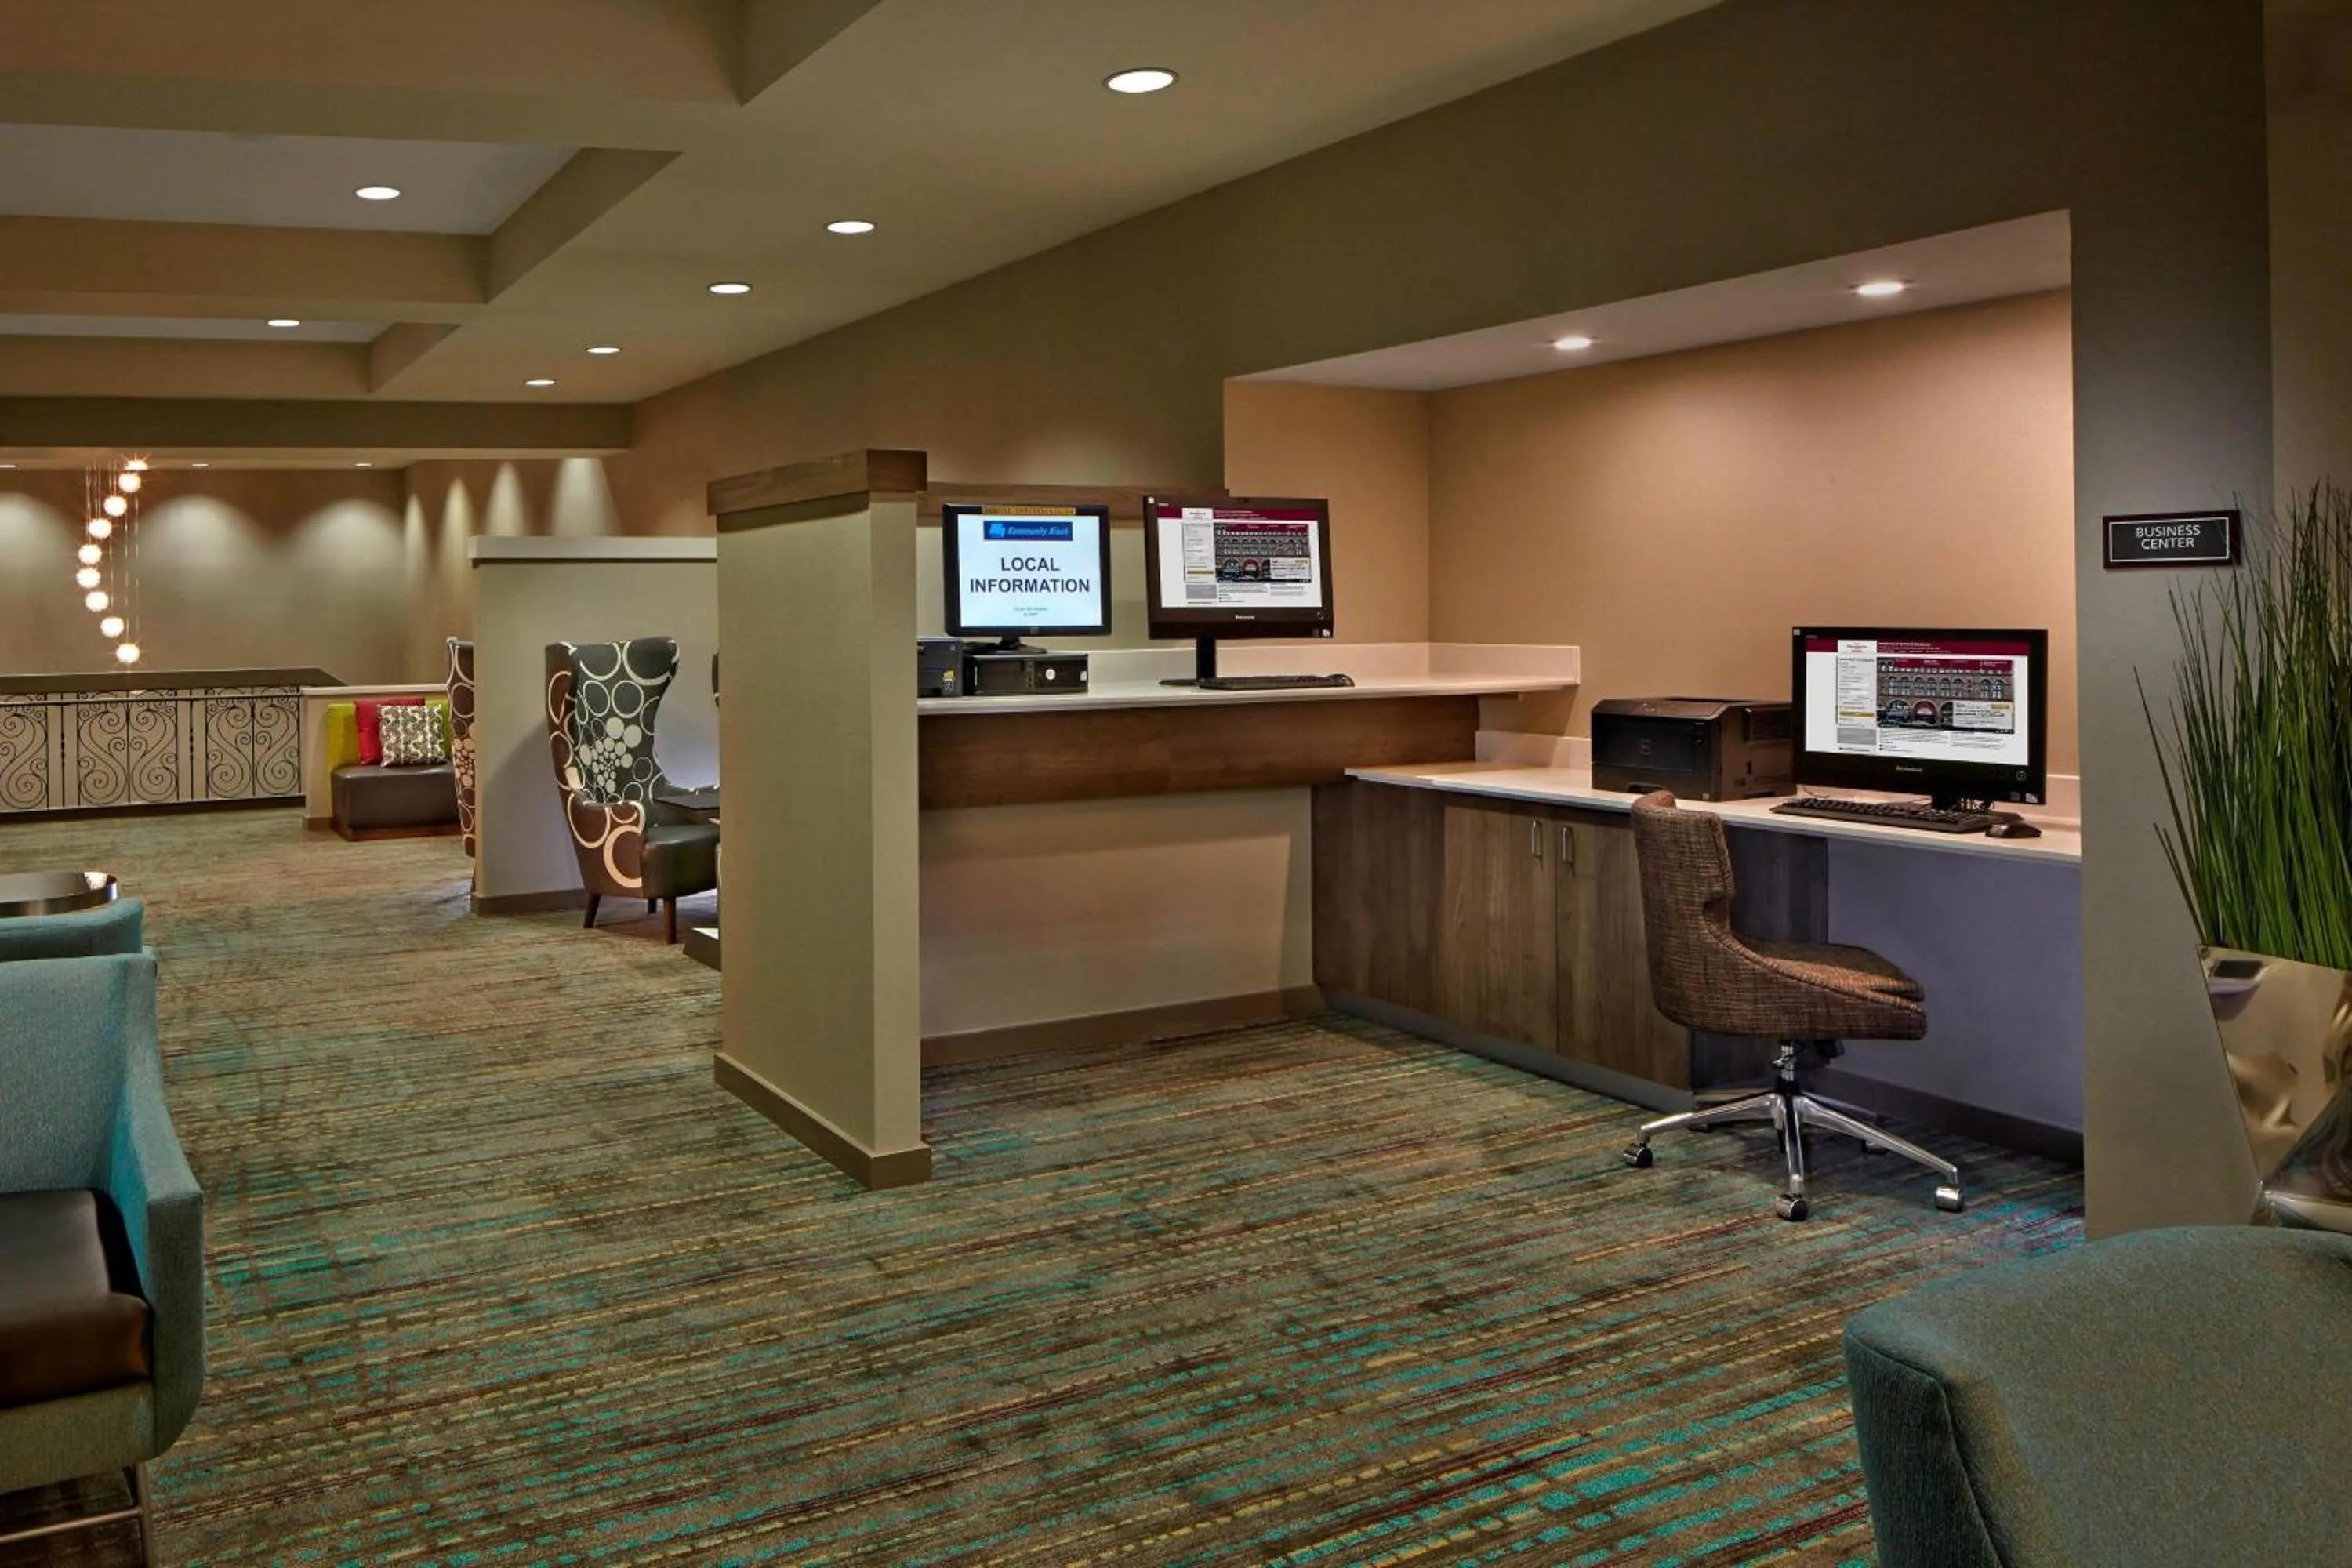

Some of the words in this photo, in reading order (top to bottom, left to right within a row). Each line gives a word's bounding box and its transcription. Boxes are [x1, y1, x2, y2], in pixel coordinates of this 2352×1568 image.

[2135, 524, 2201, 538] BUSINESS
[2141, 537, 2195, 549] CENTER
[1001, 557, 1060, 572] LOCAL
[970, 579, 1090, 593] INFORMATION
